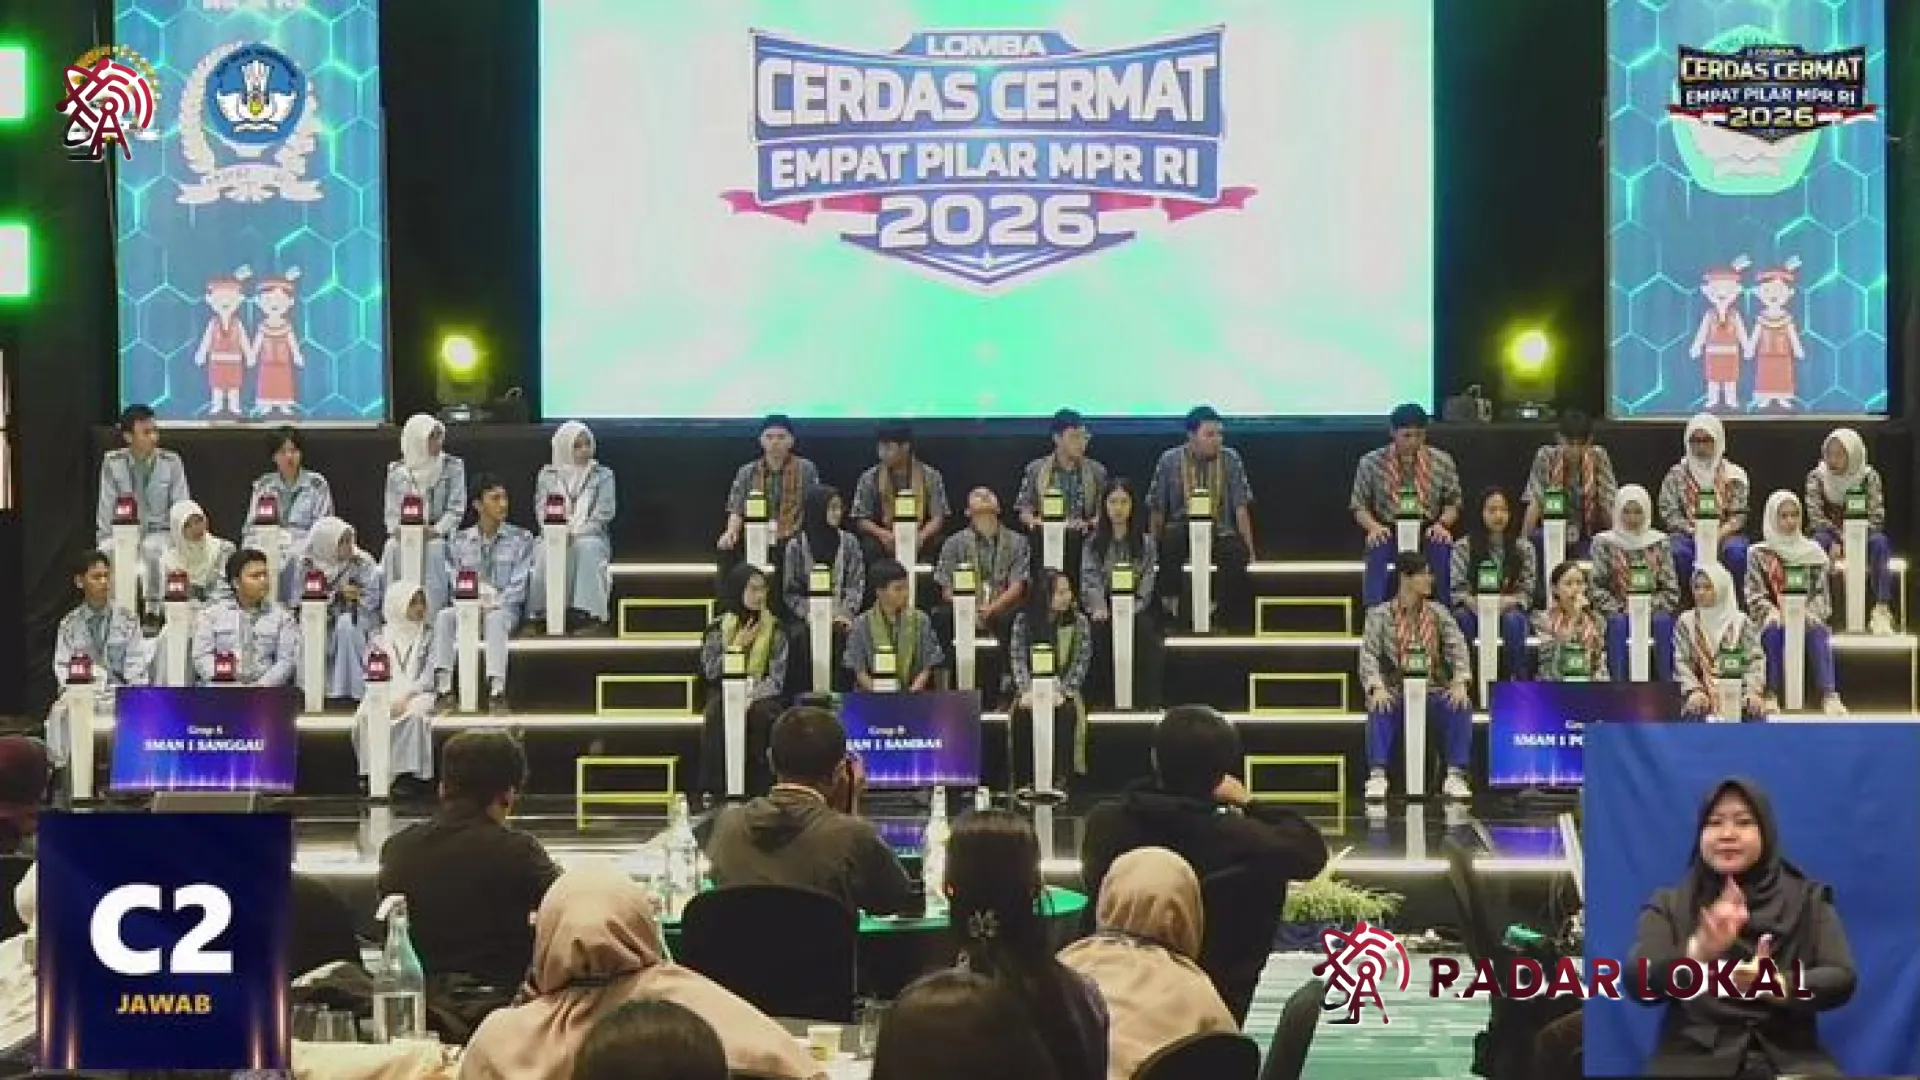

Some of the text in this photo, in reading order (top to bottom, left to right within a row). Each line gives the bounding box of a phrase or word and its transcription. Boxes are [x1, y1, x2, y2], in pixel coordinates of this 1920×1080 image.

[927, 34, 1047, 56] LOMBA
[757, 53, 1218, 126] CERDAS CERMAT
[770, 142, 1198, 189] EMPAT PILAR MPR RI
[879, 194, 1098, 249] 2026
